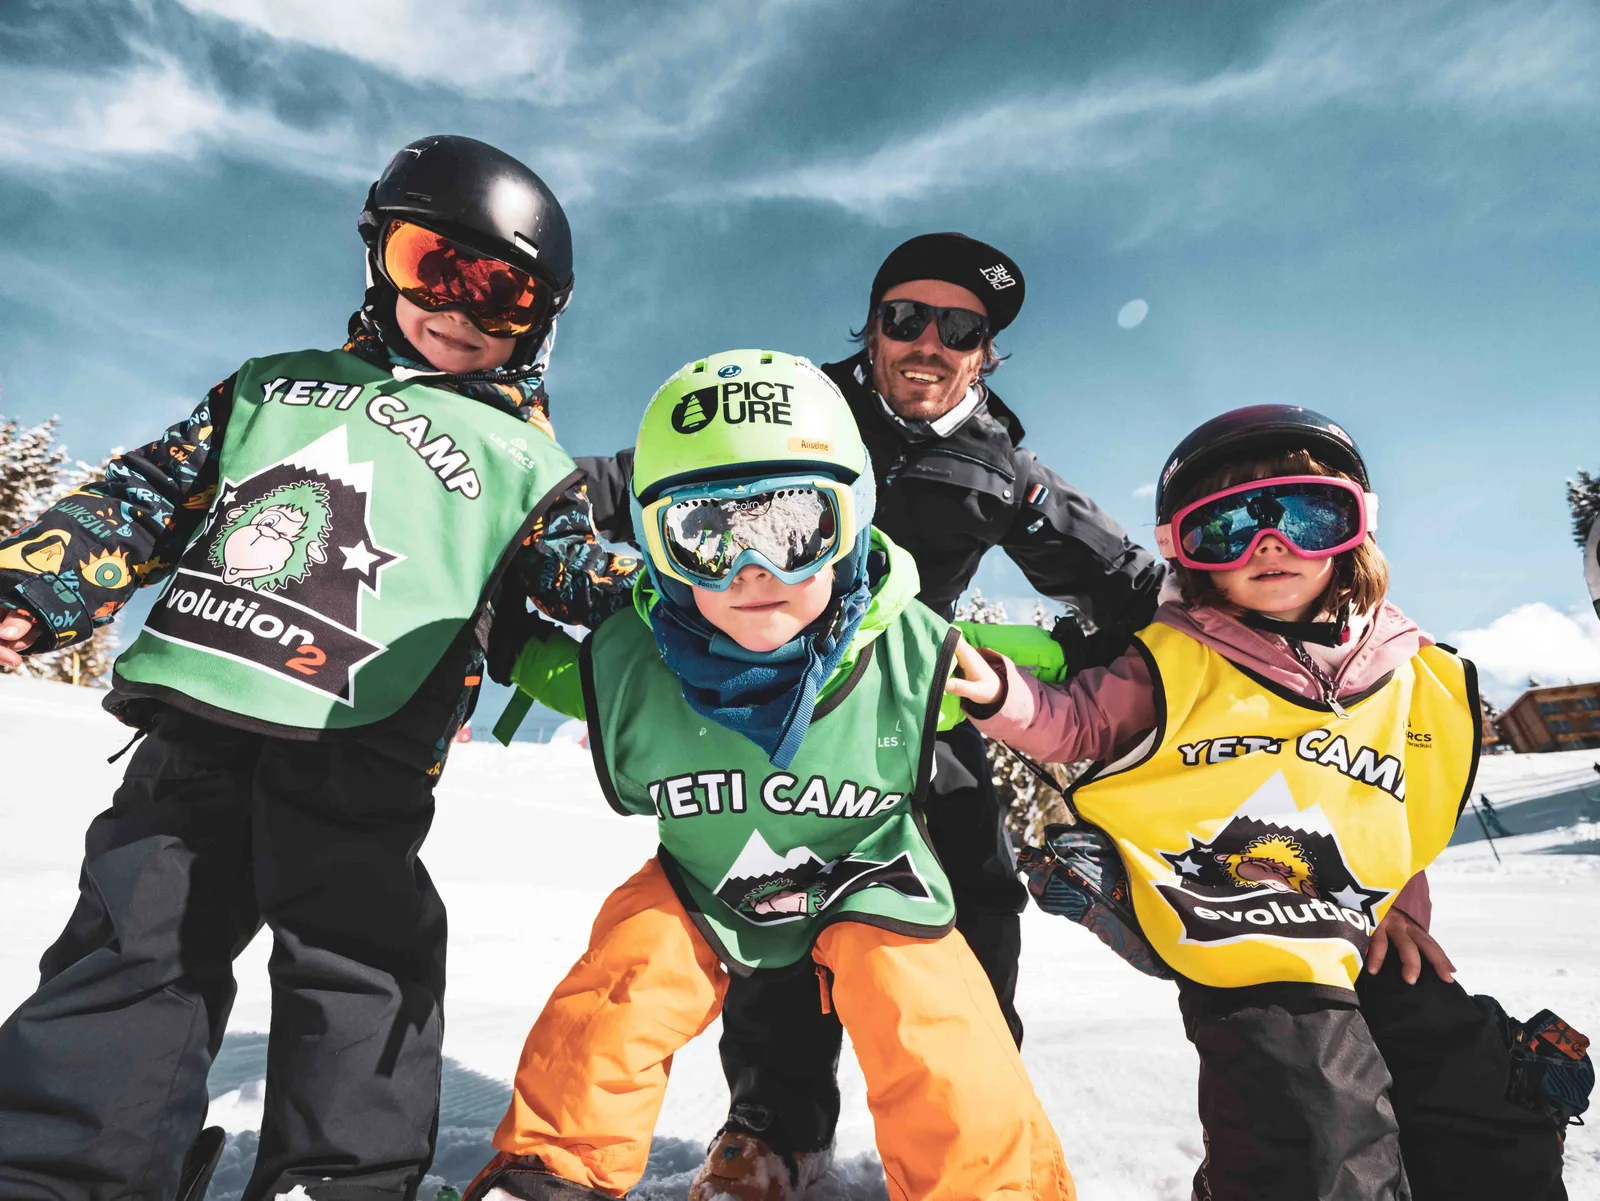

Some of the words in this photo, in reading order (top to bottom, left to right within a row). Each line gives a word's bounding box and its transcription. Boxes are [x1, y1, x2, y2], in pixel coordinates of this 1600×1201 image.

[979, 268, 1006, 290] PICT
[992, 263, 1016, 288] URE
[722, 381, 794, 403] PICT
[722, 401, 793, 425] URE
[260, 376, 365, 412] YETI
[365, 395, 481, 500] CAMP
[507, 448, 535, 469] ARCS
[735, 500, 760, 511] cairn
[877, 736, 899, 748] LES
[1405, 730, 1432, 742] RCS
[760, 771, 905, 820] CAMP
